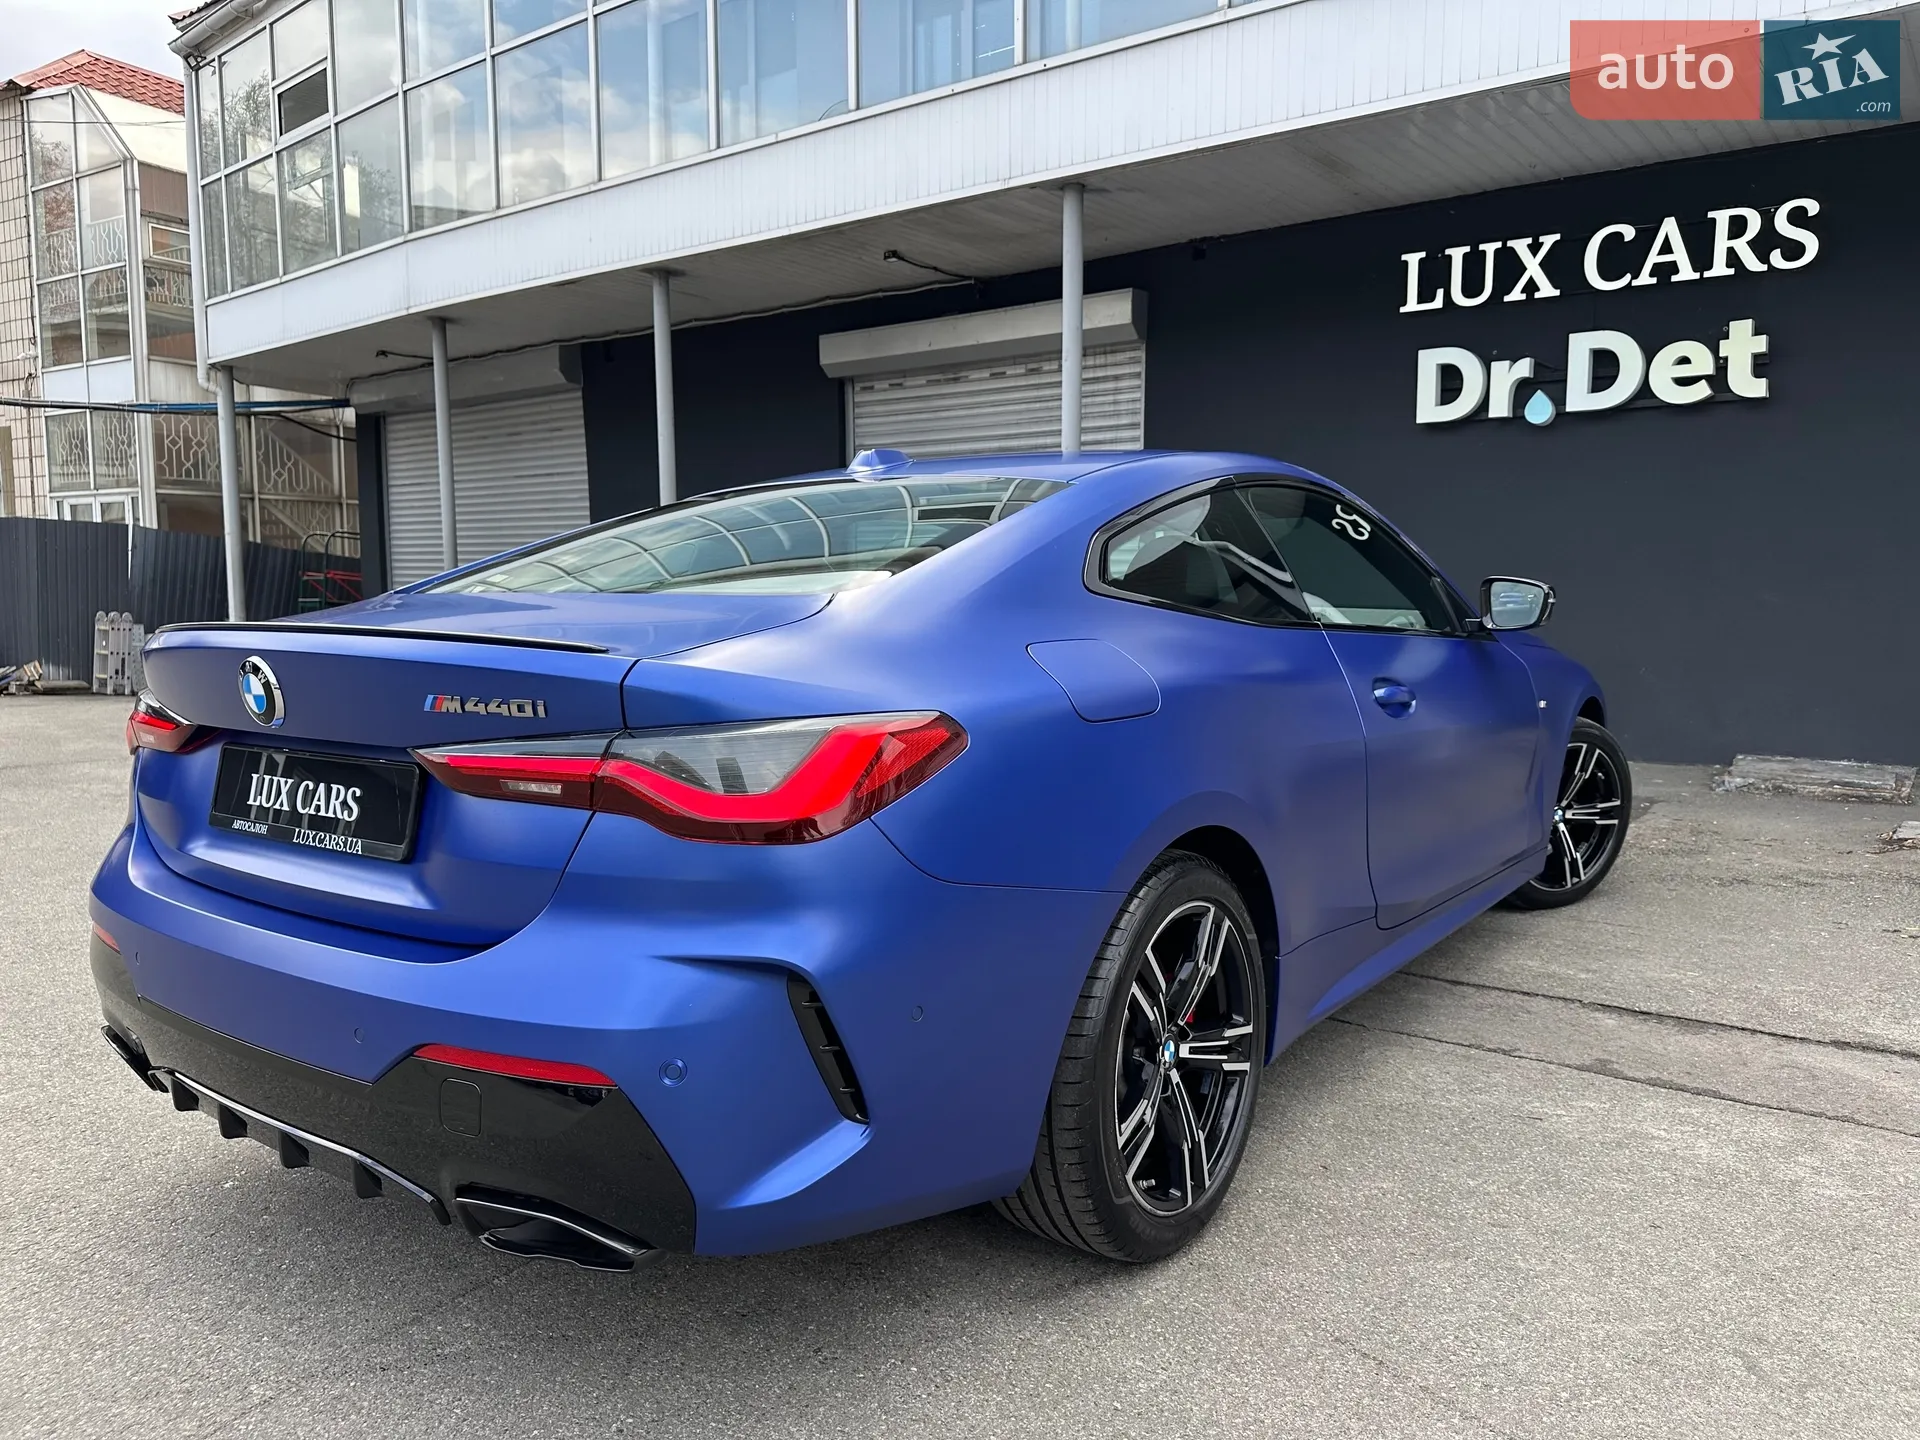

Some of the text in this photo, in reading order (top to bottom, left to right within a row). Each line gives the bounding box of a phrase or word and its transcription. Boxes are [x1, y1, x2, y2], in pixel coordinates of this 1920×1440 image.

[1399, 197, 1820, 313] LUX CARS
[440, 695, 547, 718] M440i
[247, 773, 362, 822] LUX CARS
[232, 819, 268, 835] АВТОСАЛОН
